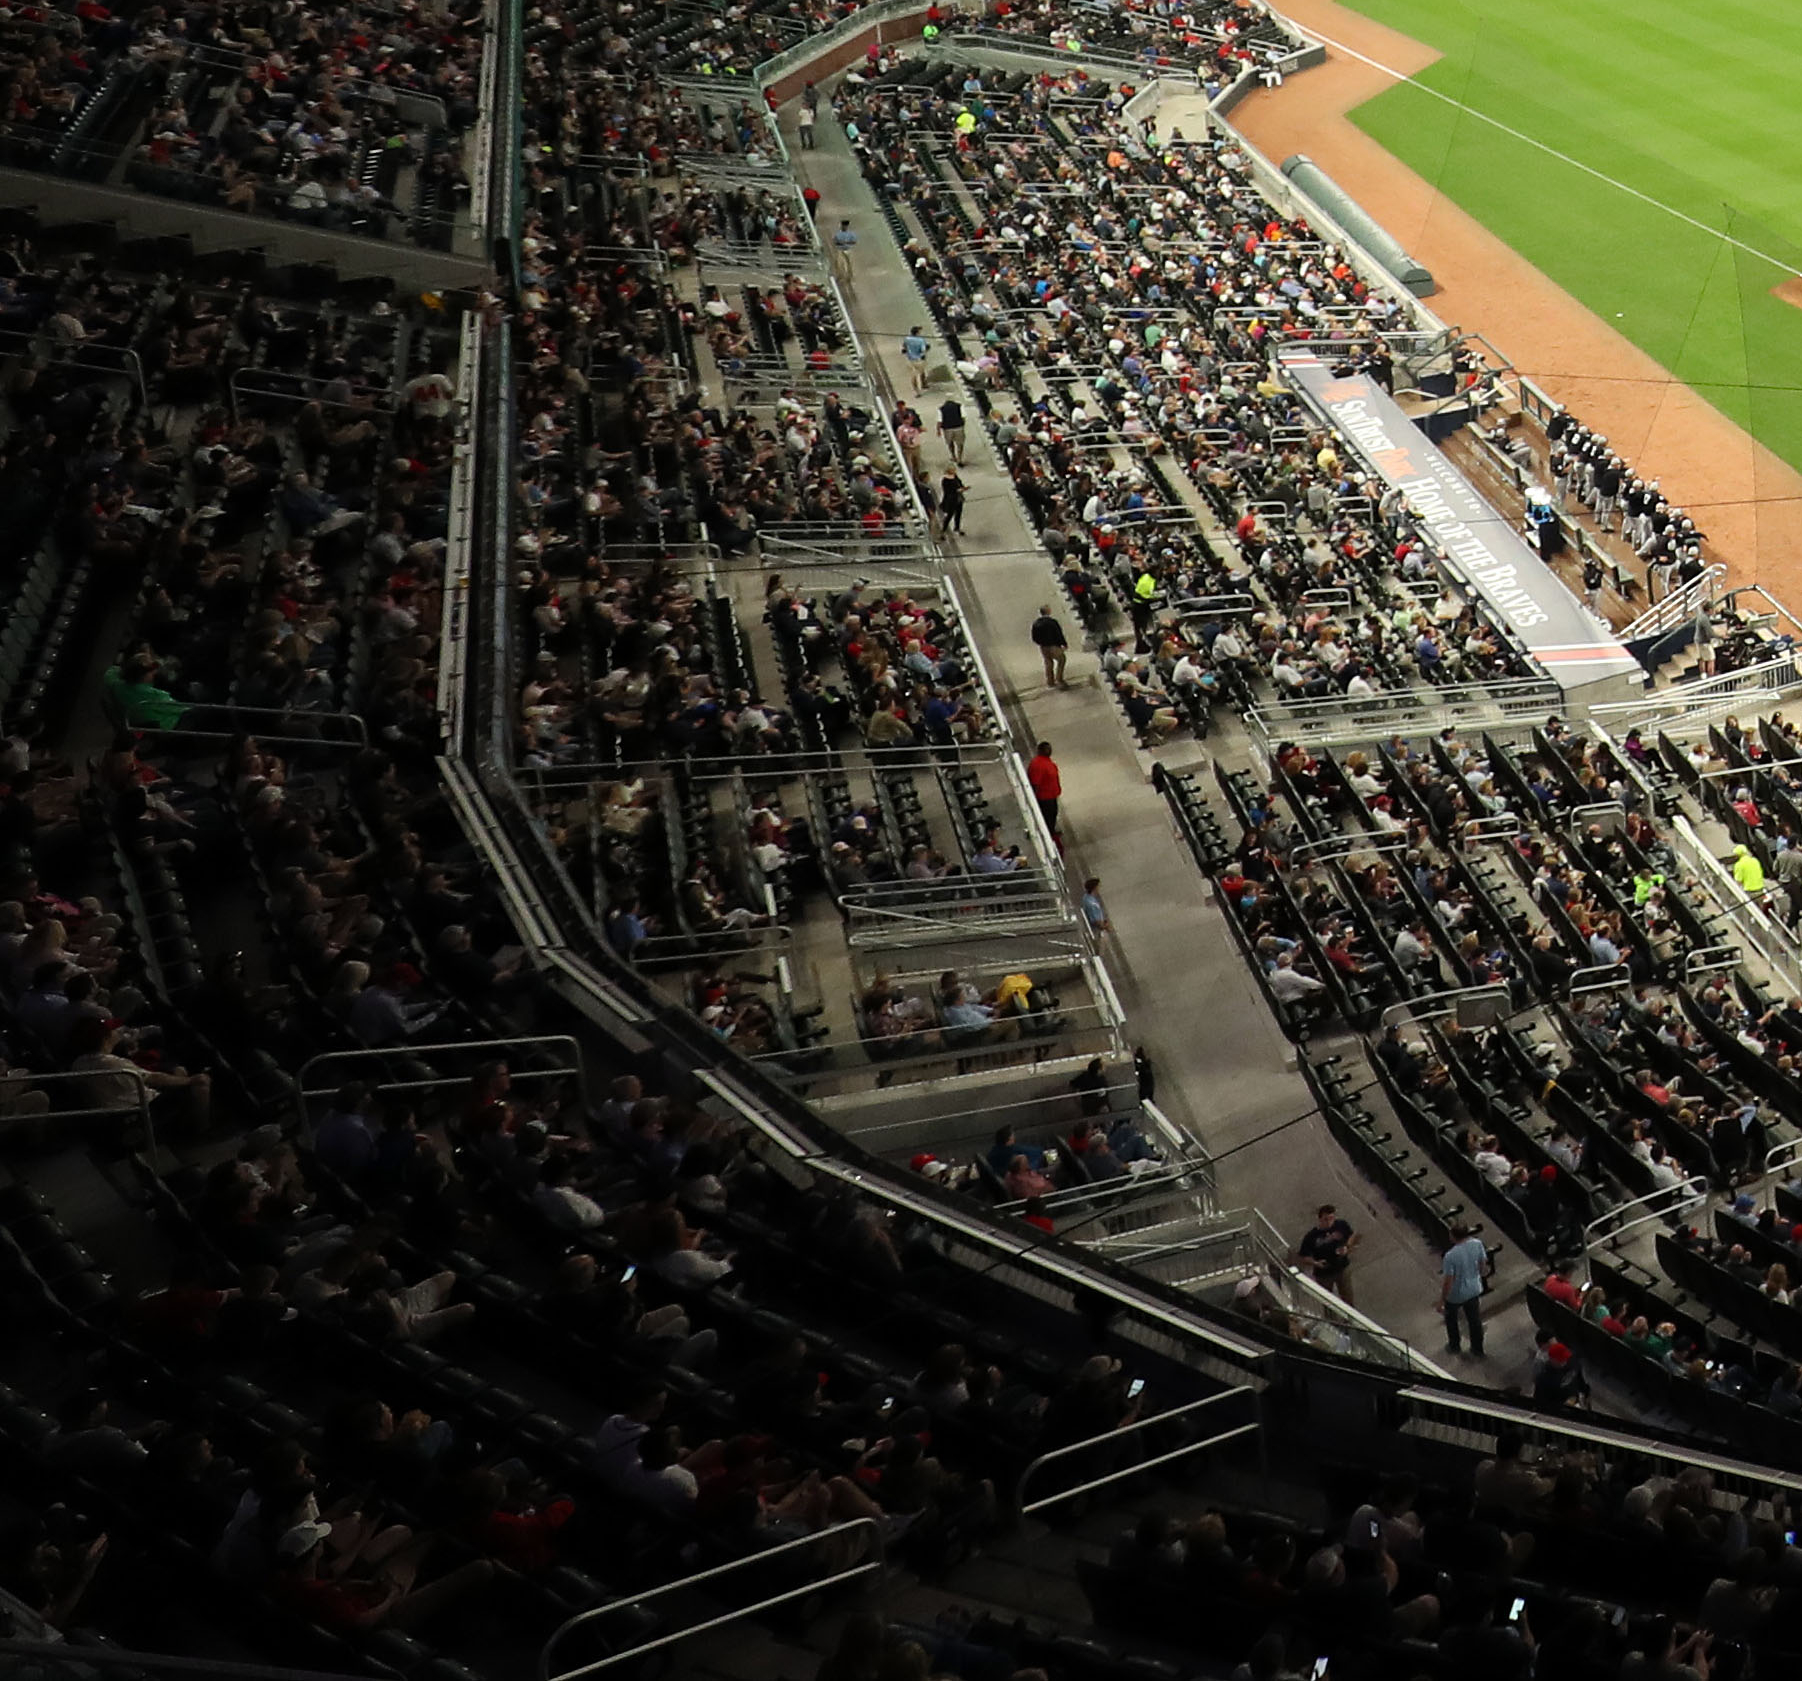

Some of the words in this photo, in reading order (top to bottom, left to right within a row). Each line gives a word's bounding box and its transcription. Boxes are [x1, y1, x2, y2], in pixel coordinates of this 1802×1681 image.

[1399, 475, 1456, 524] HOME
[1437, 519, 1473, 544] OF
[1451, 537, 1498, 573] THE
[1475, 561, 1550, 628] BRAVES
